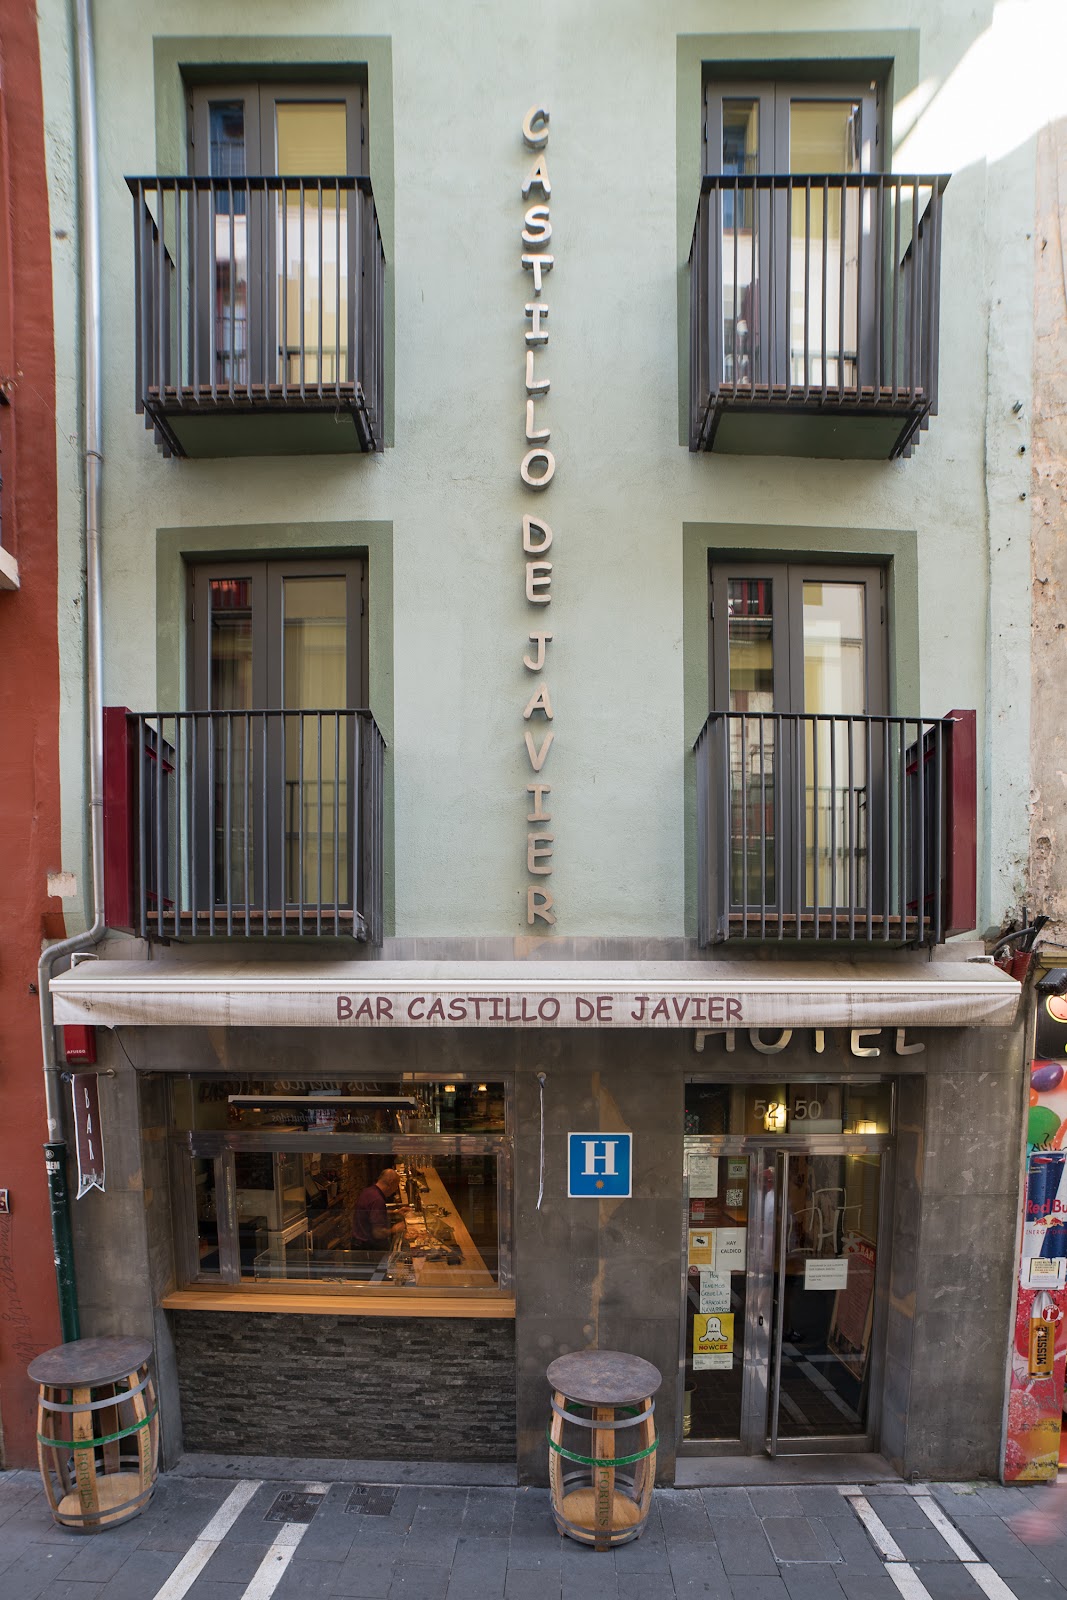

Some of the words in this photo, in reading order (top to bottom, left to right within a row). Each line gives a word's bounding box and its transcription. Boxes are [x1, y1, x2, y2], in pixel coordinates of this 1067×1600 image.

[521, 103, 556, 491] CASTILLO
[522, 513, 554, 607] DE
[522, 631, 558, 927] JAVIER
[337, 995, 394, 1020] BAR
[407, 996, 560, 1021] CASTILLO
[575, 996, 613, 1021] DE
[631, 996, 743, 1021] JAVIER
[580, 1140, 620, 1176] H
[1027, 1198, 1051, 1215] Red
[861, 1244, 875, 1262] BAR
[599, 1471, 610, 1527] FORTIUS
